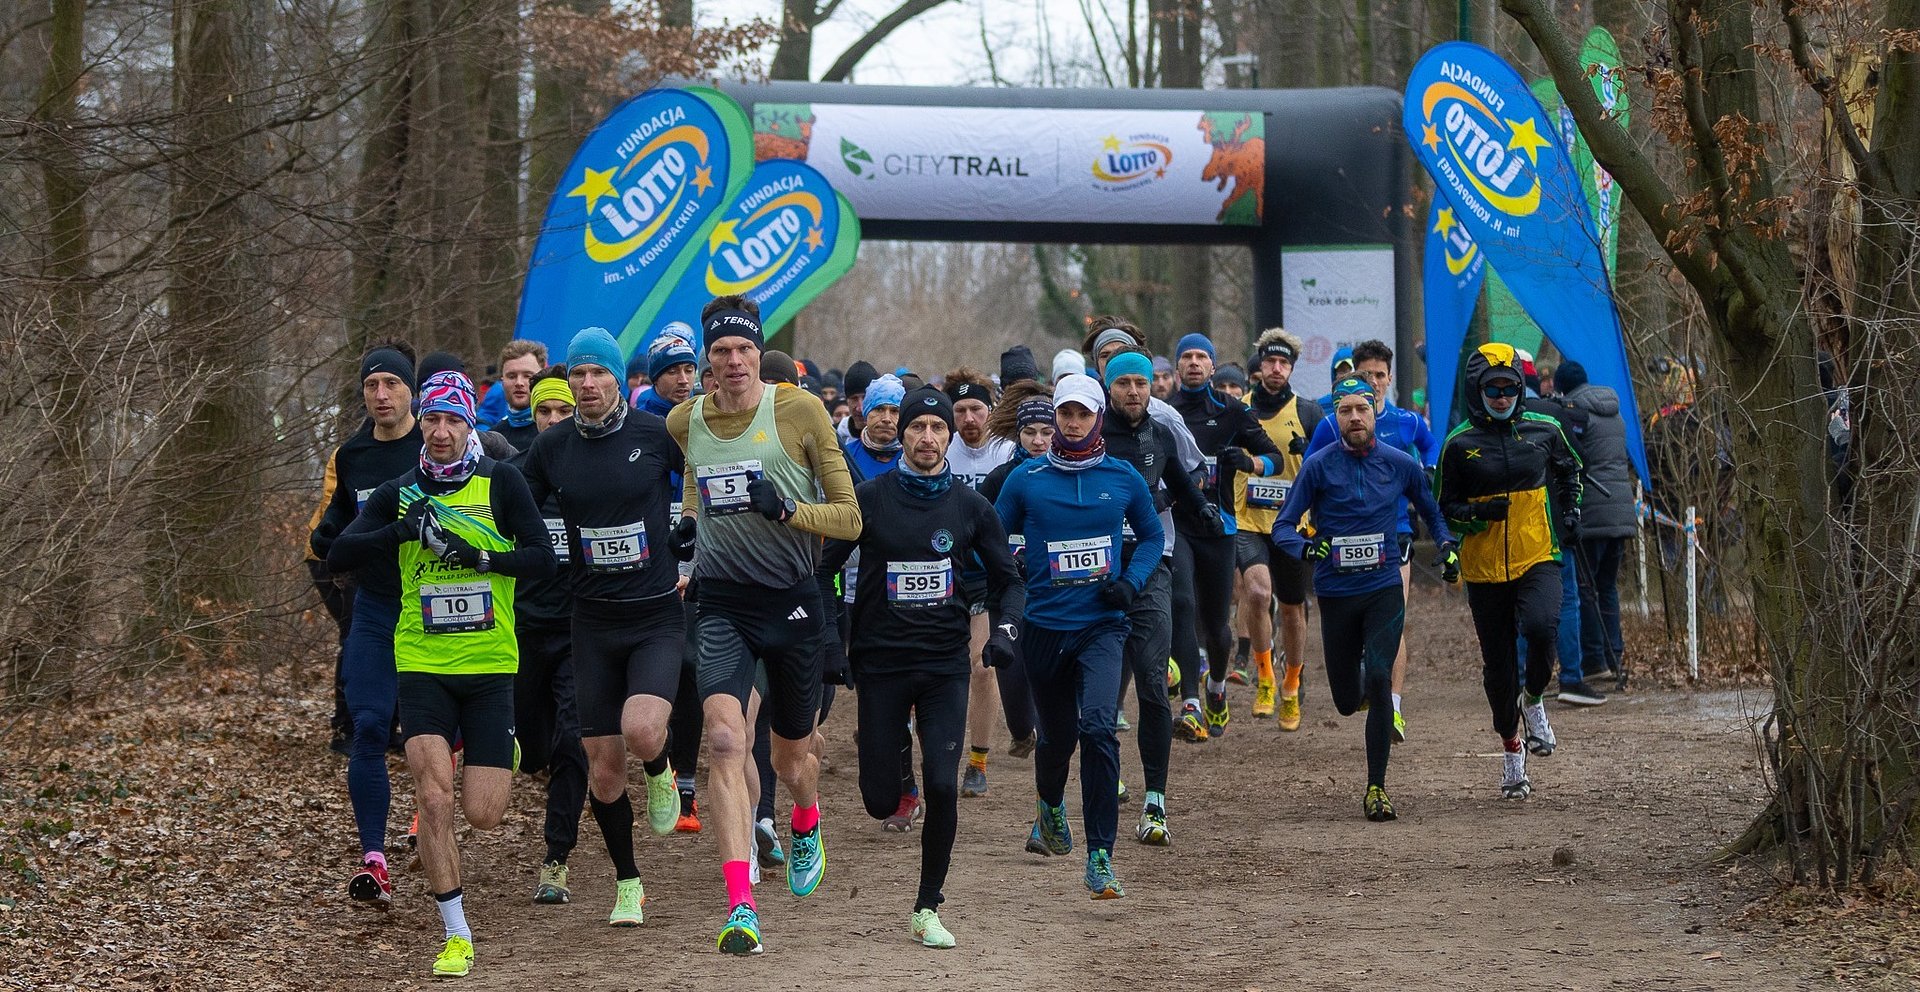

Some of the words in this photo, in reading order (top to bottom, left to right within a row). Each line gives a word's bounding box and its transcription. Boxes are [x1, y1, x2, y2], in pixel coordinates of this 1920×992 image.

[616, 106, 686, 160] FUNDACJA
[1107, 150, 1157, 174] LOTTO
[600, 147, 686, 238] LOTTO
[740, 175, 804, 214] FUNDACJA
[604, 270, 624, 285] im.
[625, 261, 640, 277] H.
[640, 199, 699, 267] KONOPACKIEJ
[721, 208, 800, 280] LOTTO
[723, 316, 760, 334] TERREX
[725, 479, 735, 494] 5
[1255, 487, 1283, 499] 1225
[598, 540, 631, 556] 154
[1345, 547, 1374, 559] 580
[1064, 552, 1099, 568] 1161
[904, 576, 940, 591] 595
[445, 598, 468, 614] 10
